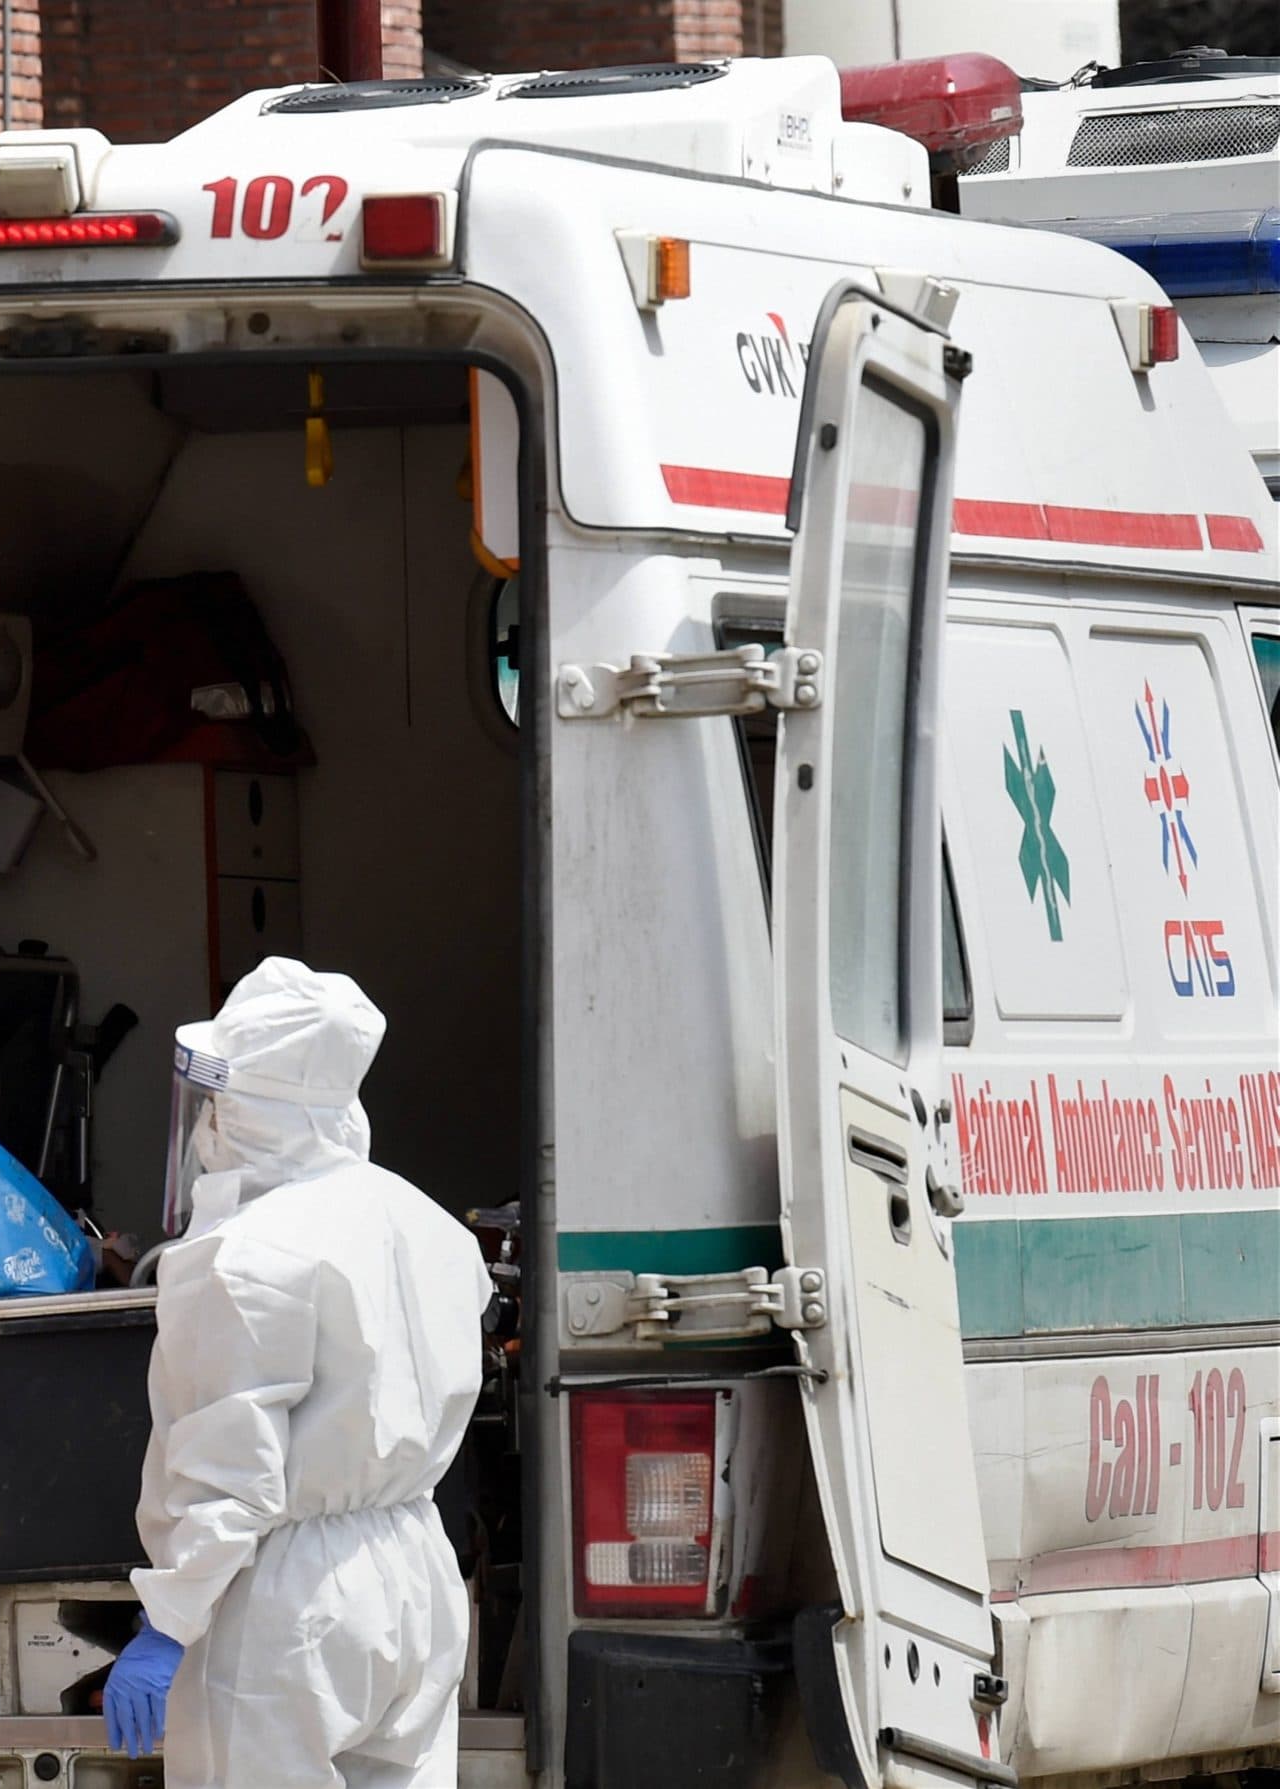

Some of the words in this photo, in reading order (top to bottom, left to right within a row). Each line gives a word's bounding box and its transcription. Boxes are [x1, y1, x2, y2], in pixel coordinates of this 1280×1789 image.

[202, 175, 348, 241] 102
[736, 332, 797, 398] GVK
[1164, 920, 1235, 996] CATS
[951, 1072, 1048, 1196] National
[1047, 1074, 1164, 1194] Ambulance
[1163, 1074, 1244, 1192] Service
[1239, 1071, 1280, 1190] (NAS
[1085, 1374, 1160, 1522] Call
[1188, 1367, 1246, 1511] 102
